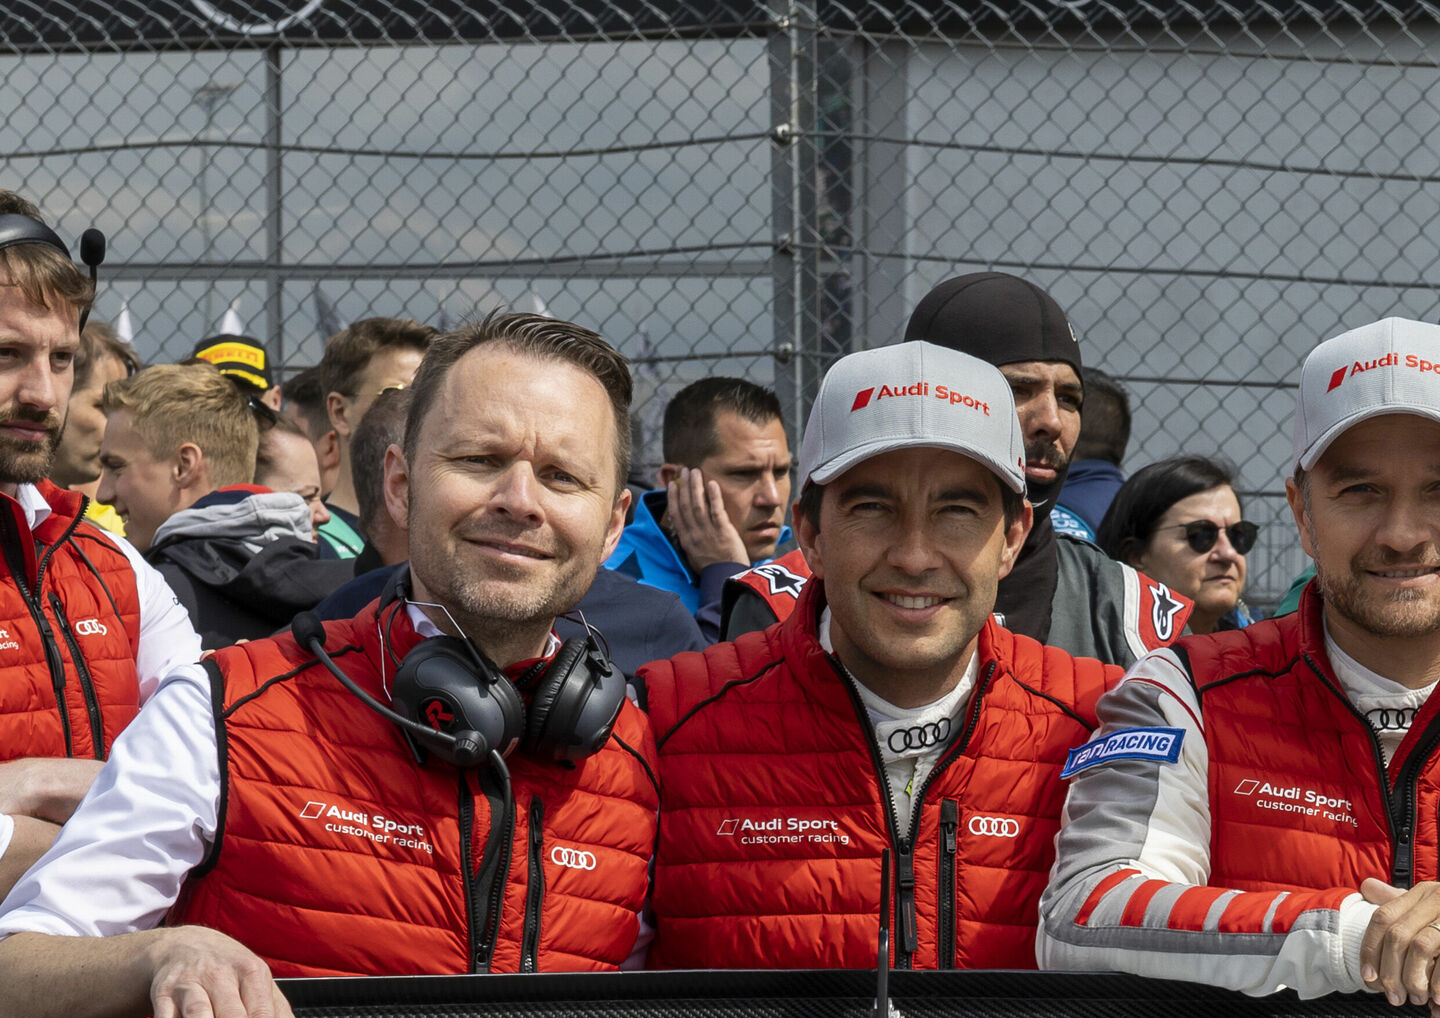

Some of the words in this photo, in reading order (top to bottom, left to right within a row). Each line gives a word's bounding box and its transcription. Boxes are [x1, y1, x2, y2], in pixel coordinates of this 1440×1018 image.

[1350, 352, 1399, 377] Audi
[877, 382, 929, 400] Audi
[935, 385, 991, 417] Sport
[1104, 735, 1170, 755] RACING
[1259, 782, 1301, 799] Audi
[1304, 790, 1353, 811] Sport
[326, 805, 369, 826] Audi
[372, 815, 424, 837] Sport
[741, 818, 782, 831] Audi
[787, 817, 839, 832] Sport
[1256, 799, 1320, 817] customer
[1322, 810, 1359, 828] racing
[325, 823, 391, 843] customer
[393, 836, 434, 854] racing
[741, 834, 804, 845] customer
[808, 832, 850, 845] racing
